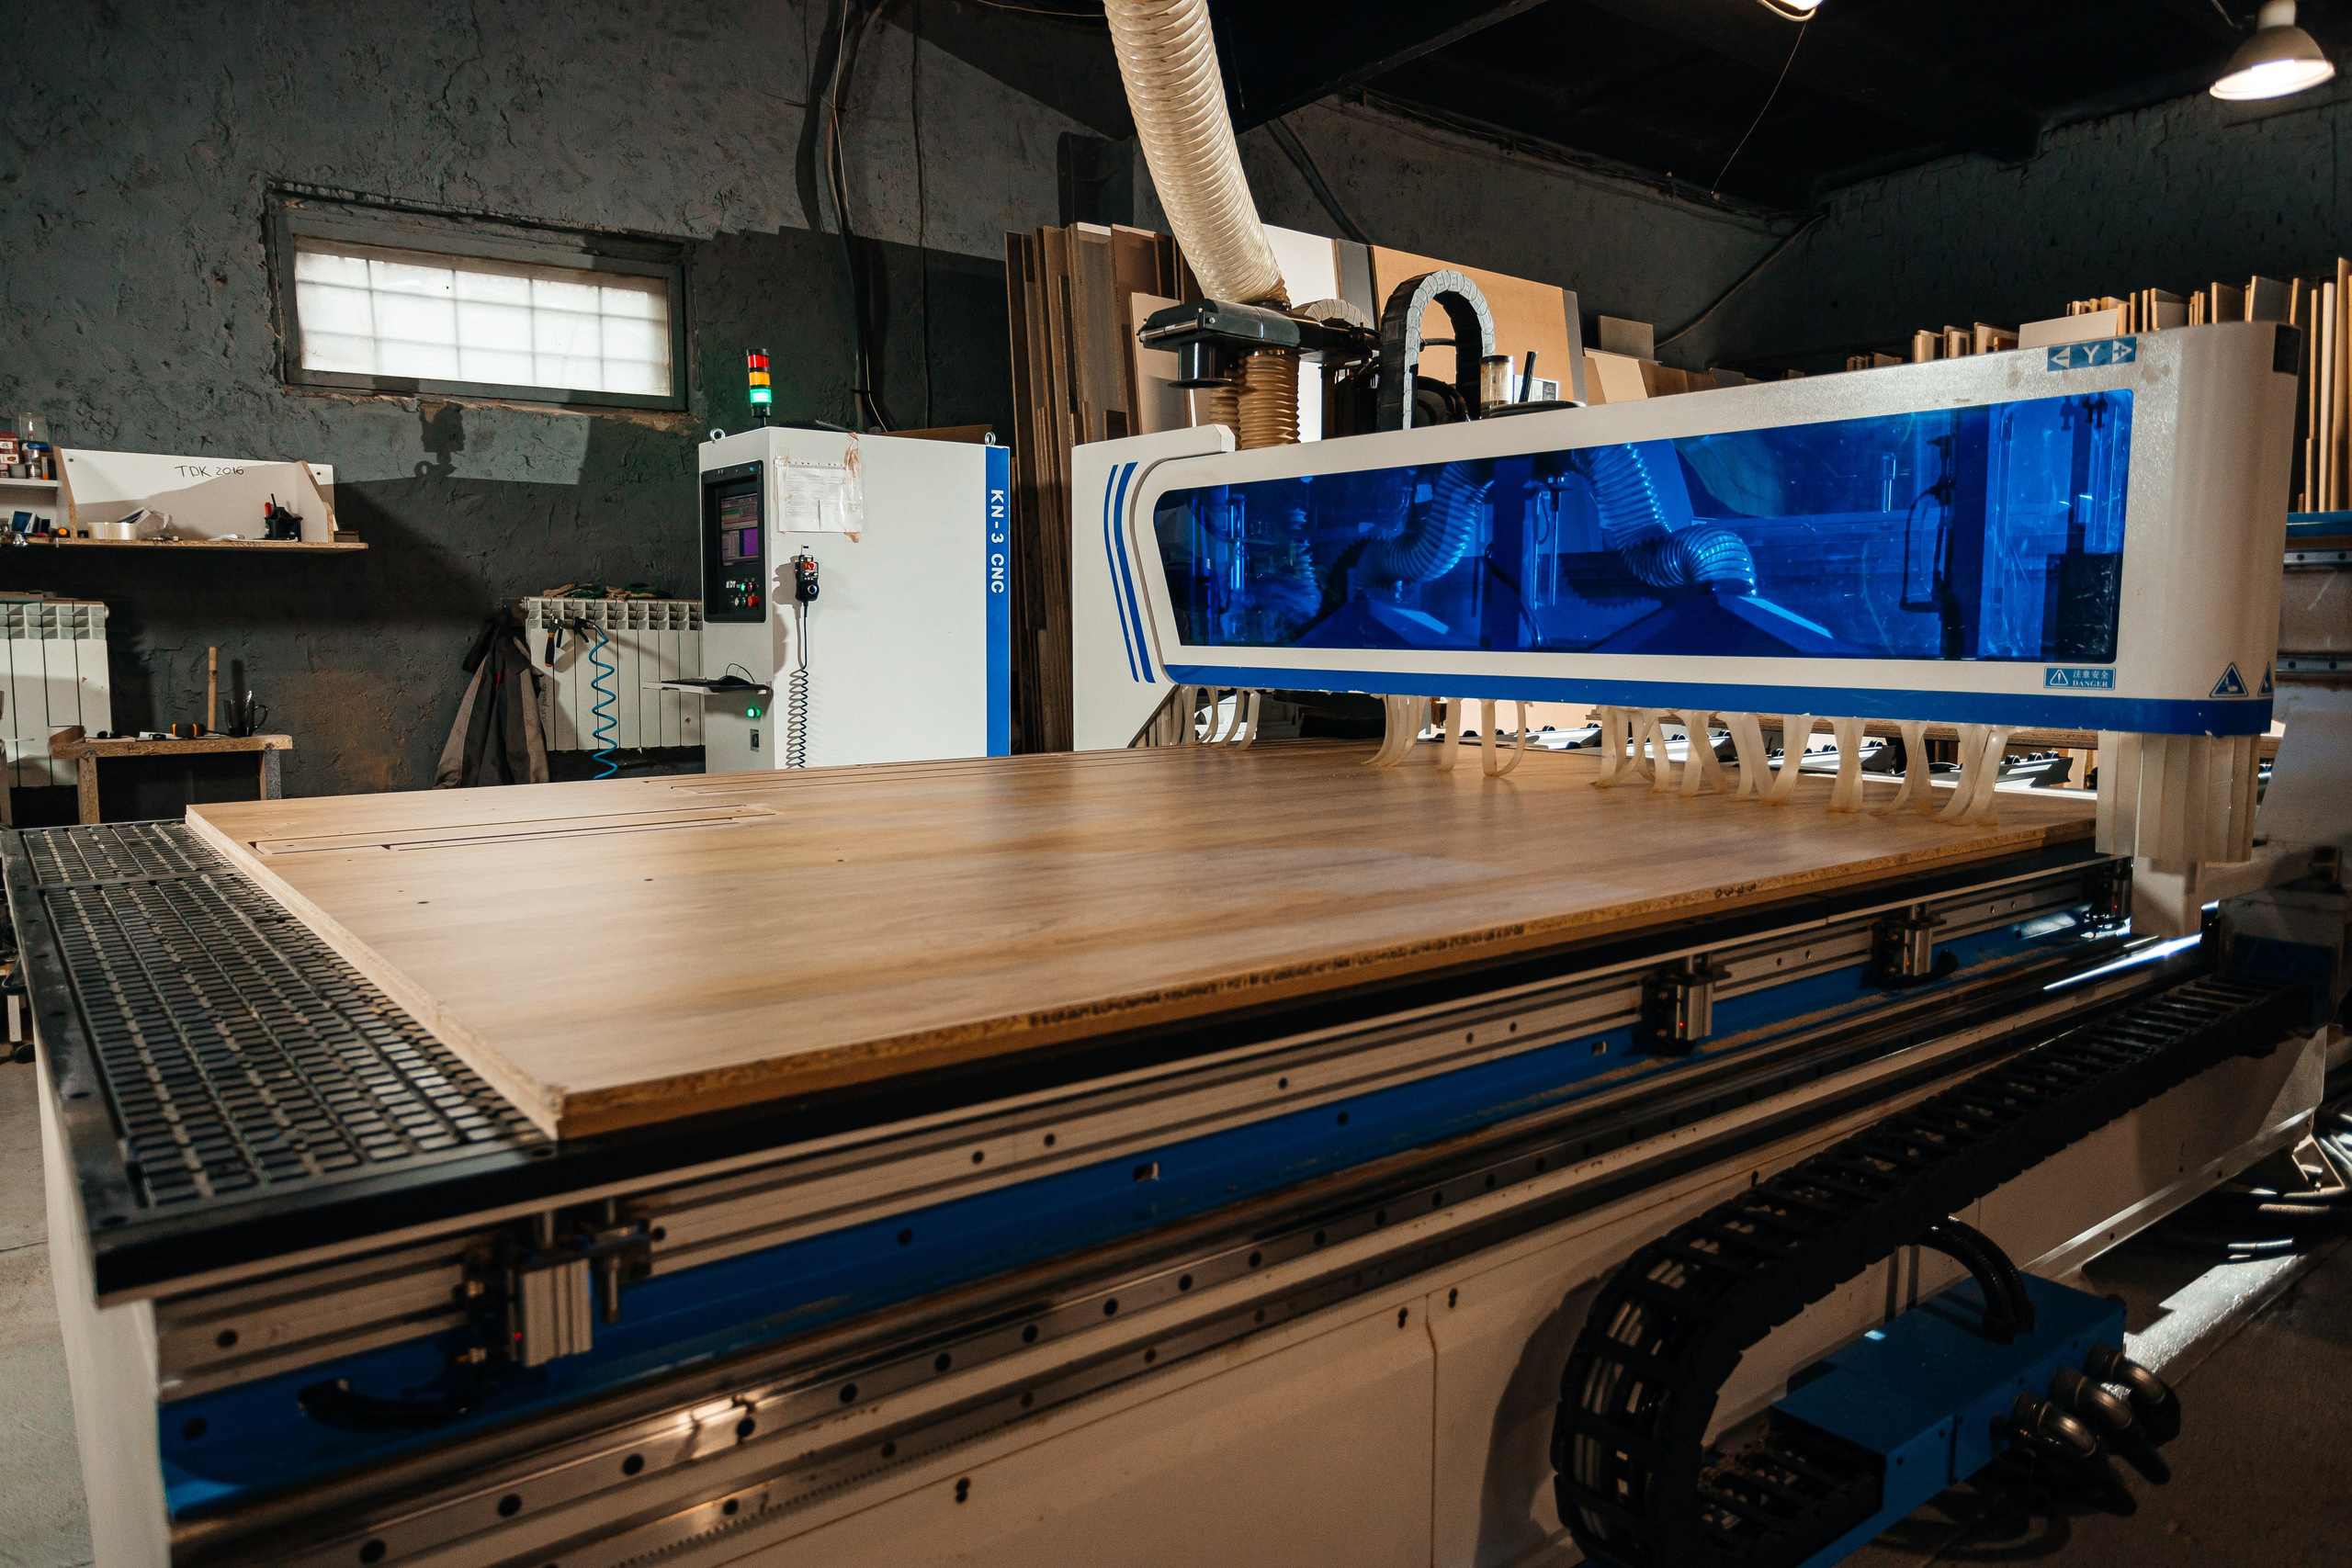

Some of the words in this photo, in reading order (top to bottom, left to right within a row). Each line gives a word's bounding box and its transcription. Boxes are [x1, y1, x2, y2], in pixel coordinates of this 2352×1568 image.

[175, 466, 212, 478] TDK
[216, 466, 244, 476] 2016
[991, 490, 1004, 544] KN-3
[991, 553, 1005, 593] CNC
[2073, 670, 2109, 679] 注意安全
